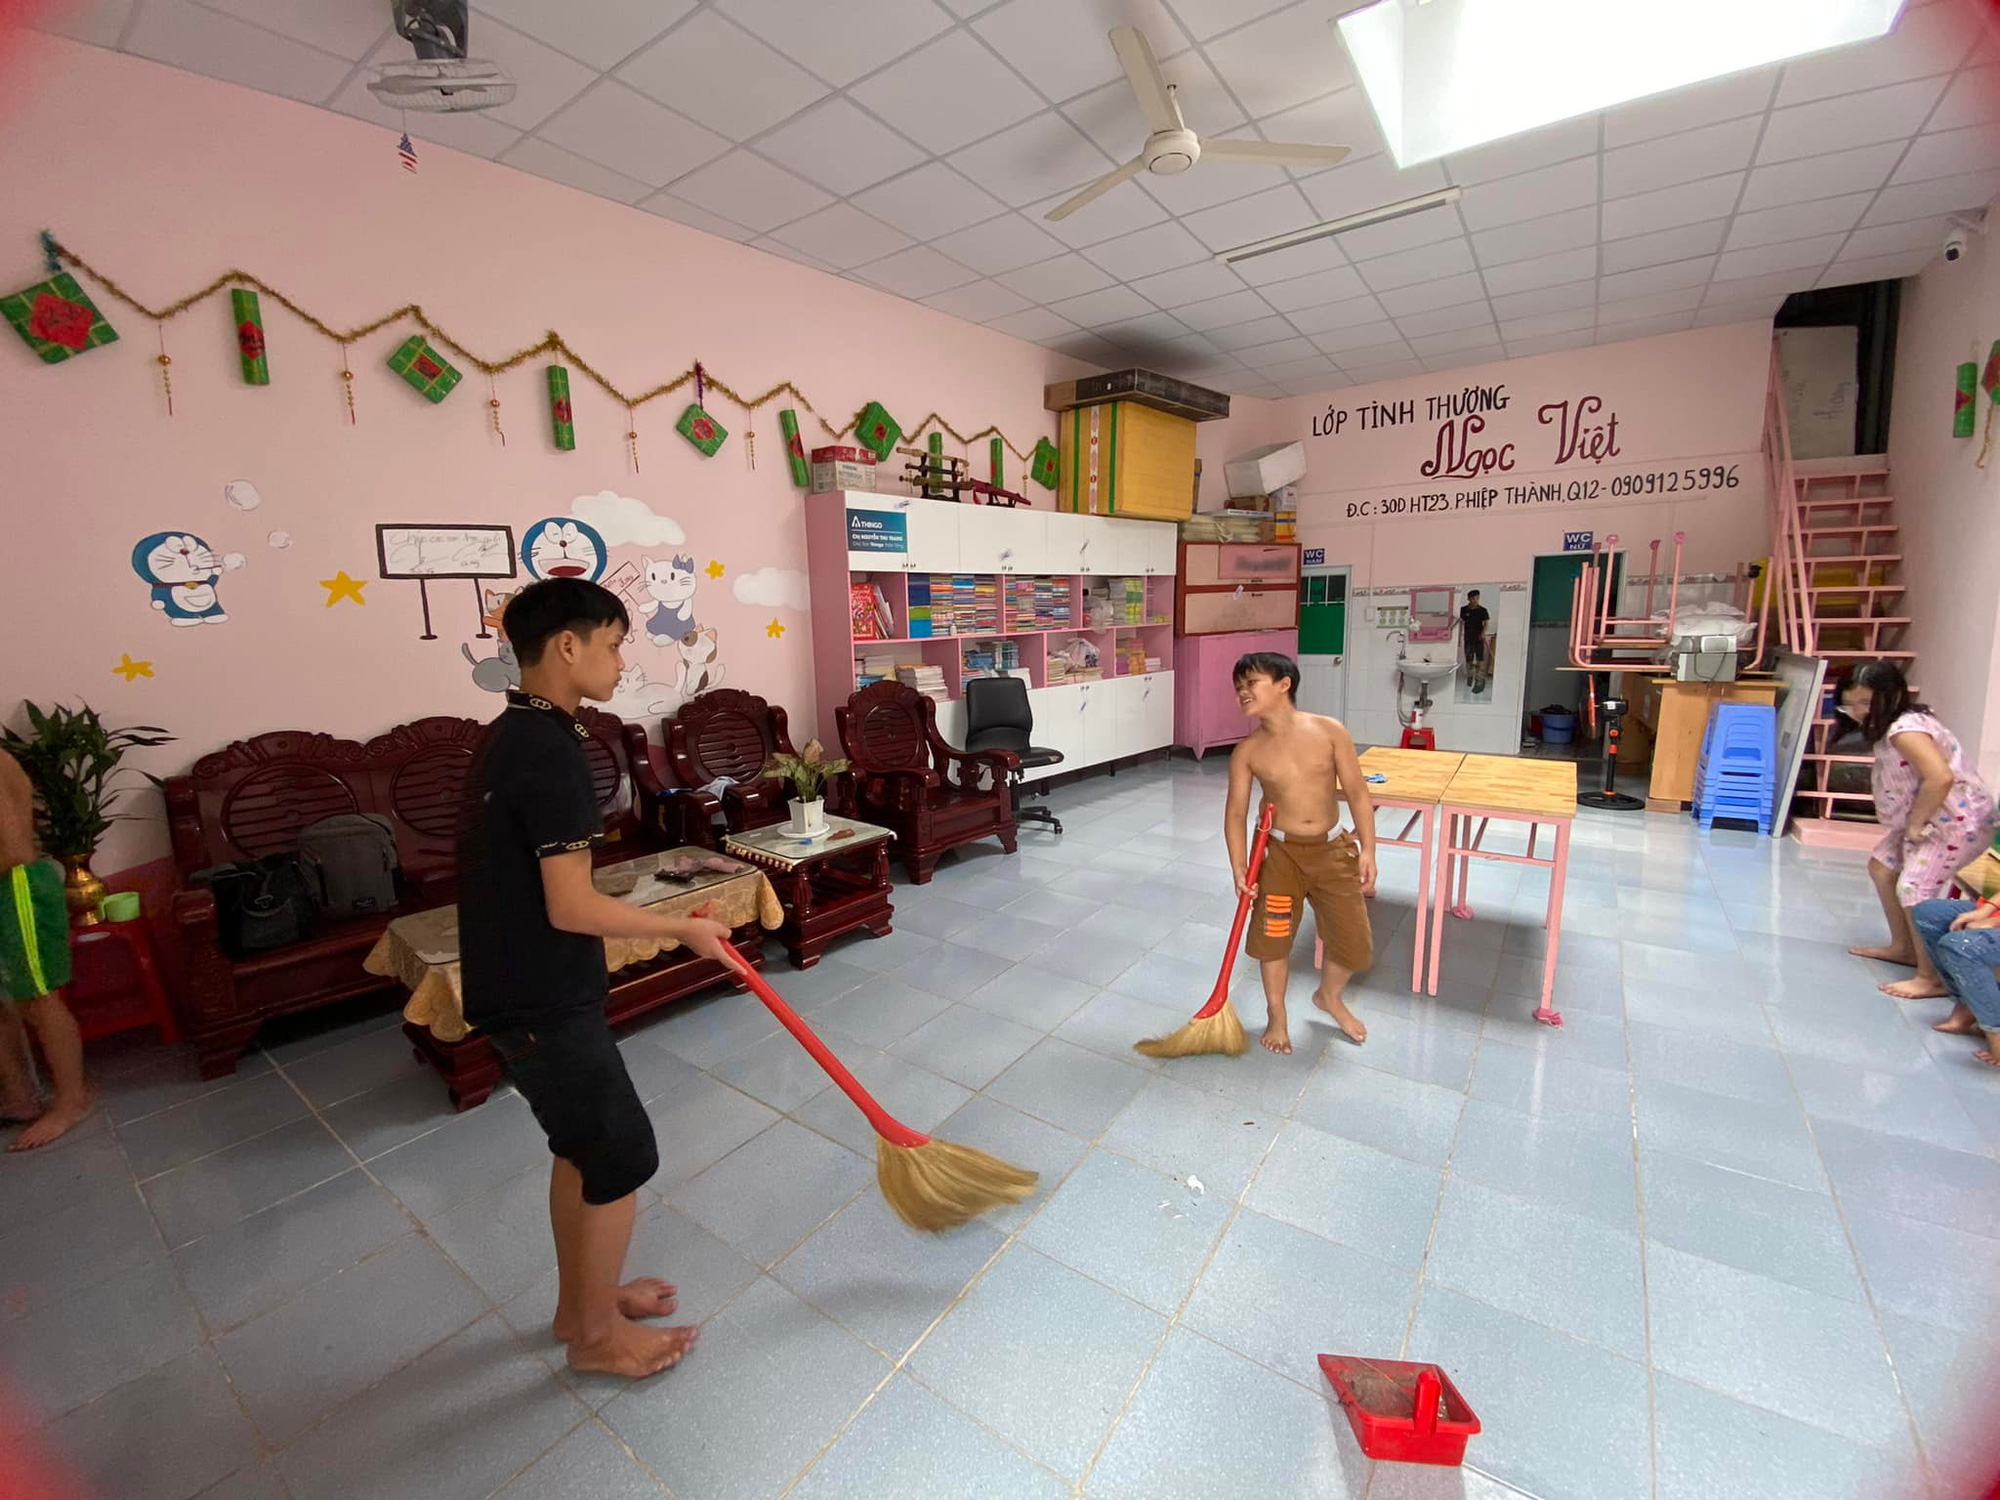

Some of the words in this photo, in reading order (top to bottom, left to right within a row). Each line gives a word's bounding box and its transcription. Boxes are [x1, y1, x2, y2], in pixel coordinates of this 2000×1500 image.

[1312, 404, 1348, 437] LỚP
[1425, 384, 1511, 421] THƯƠNG
[1420, 414, 1515, 480] Ngọc
[1537, 396, 1621, 464] Việt
[1566, 532, 1591, 543] WC
[1305, 549, 1324, 559] WC
